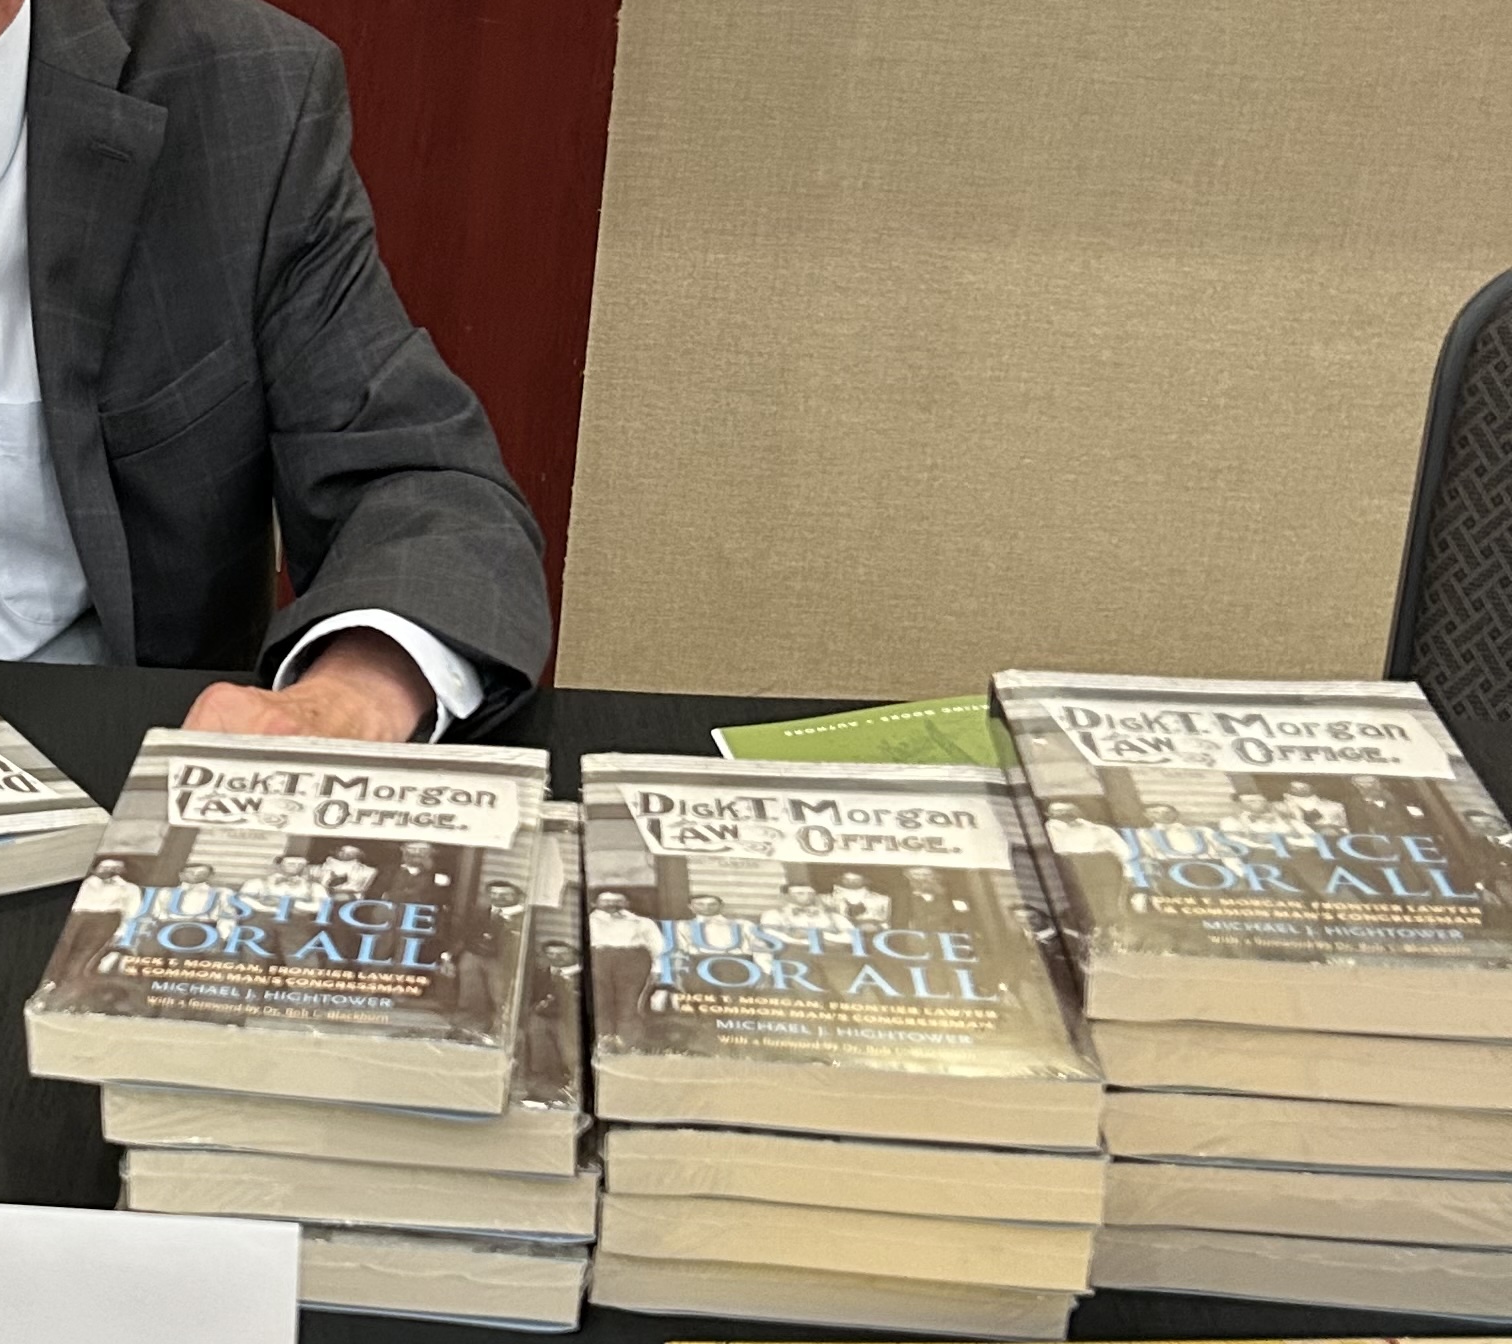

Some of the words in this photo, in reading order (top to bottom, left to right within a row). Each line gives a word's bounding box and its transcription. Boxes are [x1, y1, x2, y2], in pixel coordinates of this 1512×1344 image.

[1121, 827, 1450, 865] JUSTICE
[1124, 857, 1304, 894] FOR
[1325, 864, 1481, 902] ALL
[135, 886, 438, 935] JUSTICE
[1201, 919, 1301, 935] MICHAEL
[1323, 925, 1465, 940] HIGHTOWER
[117, 917, 275, 957] FOR
[291, 930, 438, 968] ALL
[659, 919, 980, 963] JUSTICE
[150, 981, 241, 997] MICHAEL
[263, 989, 394, 1009] HIGHTOWER
[656, 952, 825, 994] FOR
[847, 963, 1000, 1003] ALL
[715, 1018, 811, 1036] MICHAEL
[836, 1026, 974, 1045] HIGHTOWER
